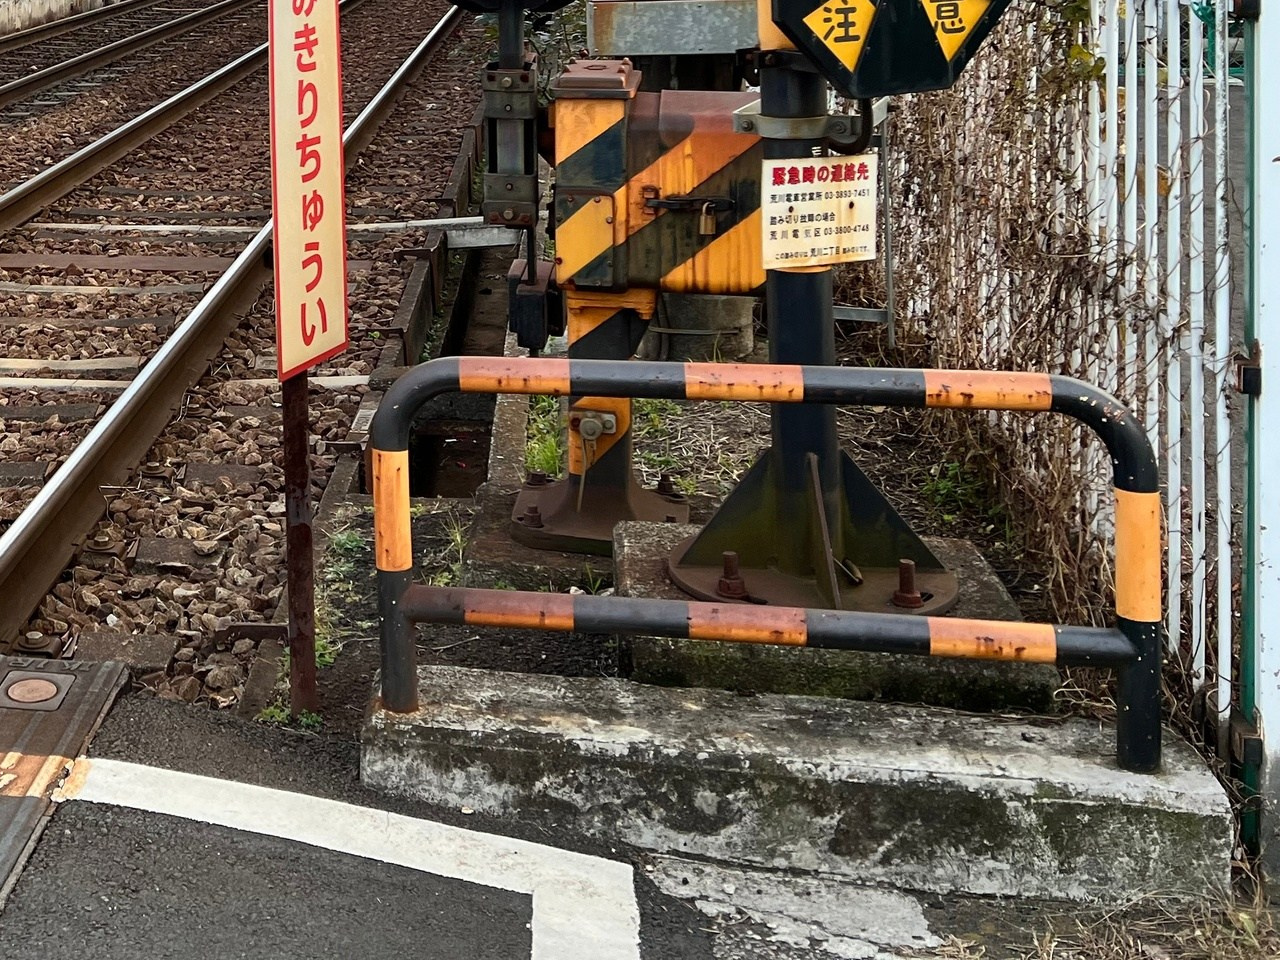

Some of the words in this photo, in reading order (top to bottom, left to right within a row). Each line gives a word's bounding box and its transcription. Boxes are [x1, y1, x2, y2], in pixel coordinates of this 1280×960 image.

[772, 162, 869, 186] 緊急時の連絡先
[770, 192, 823, 203] 荒川電車営業所
[770, 212, 836, 226] 踏み切り故障の場合
